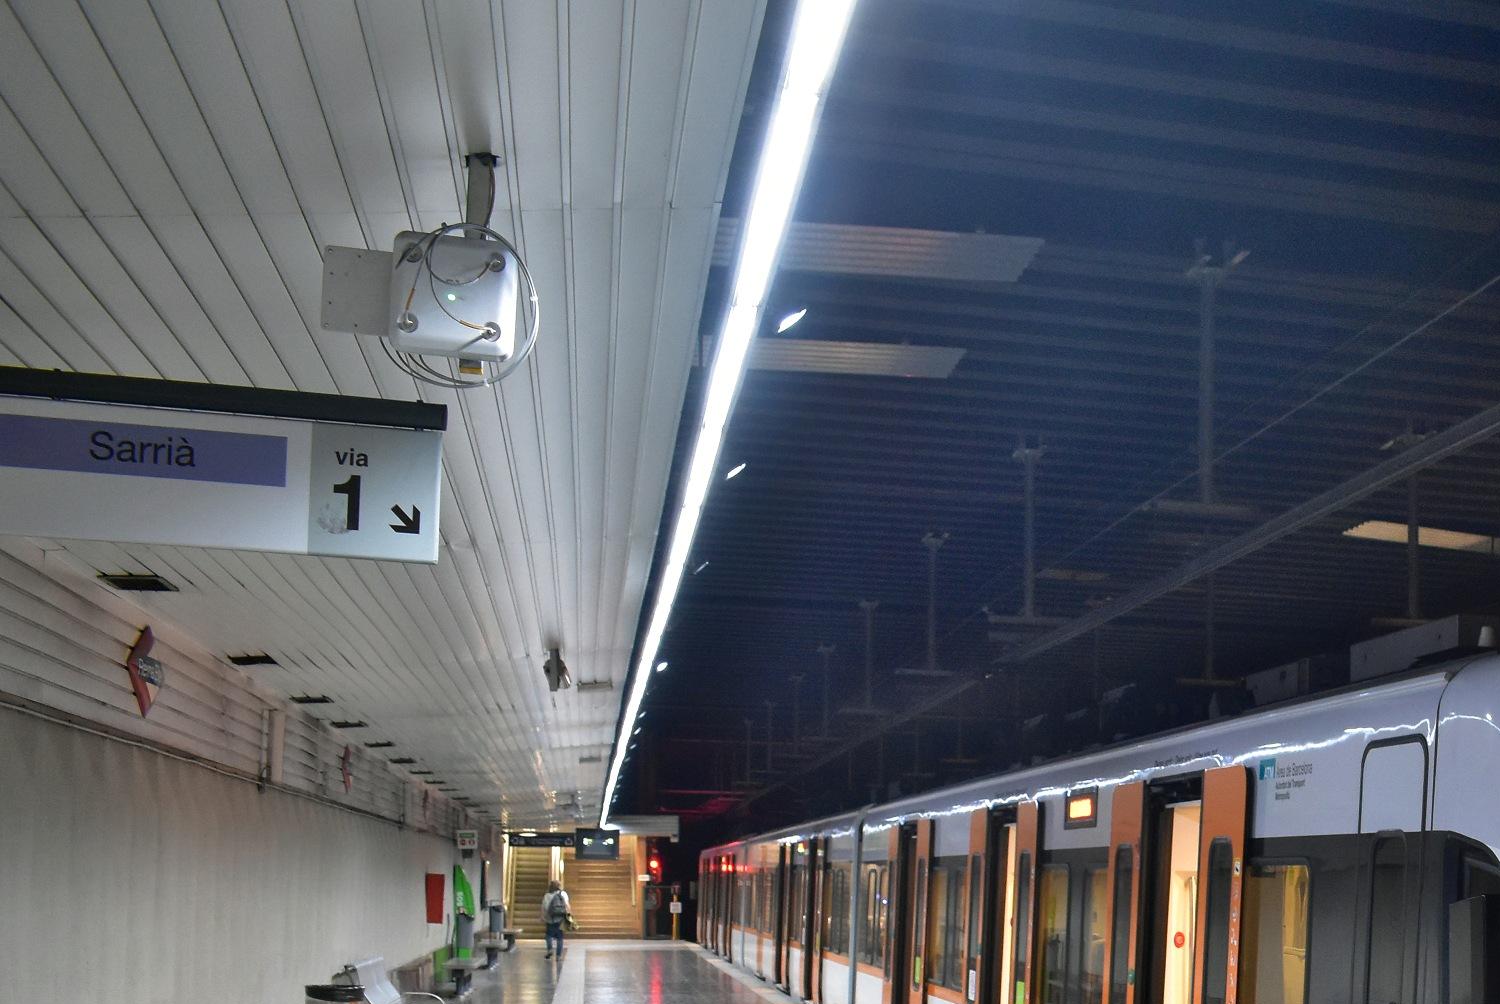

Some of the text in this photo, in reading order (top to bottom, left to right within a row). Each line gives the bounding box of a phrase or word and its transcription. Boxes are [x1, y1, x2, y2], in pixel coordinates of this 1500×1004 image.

[89, 430, 196, 468] Sarrià
[335, 448, 369, 468] via
[332, 474, 361, 531] 1
